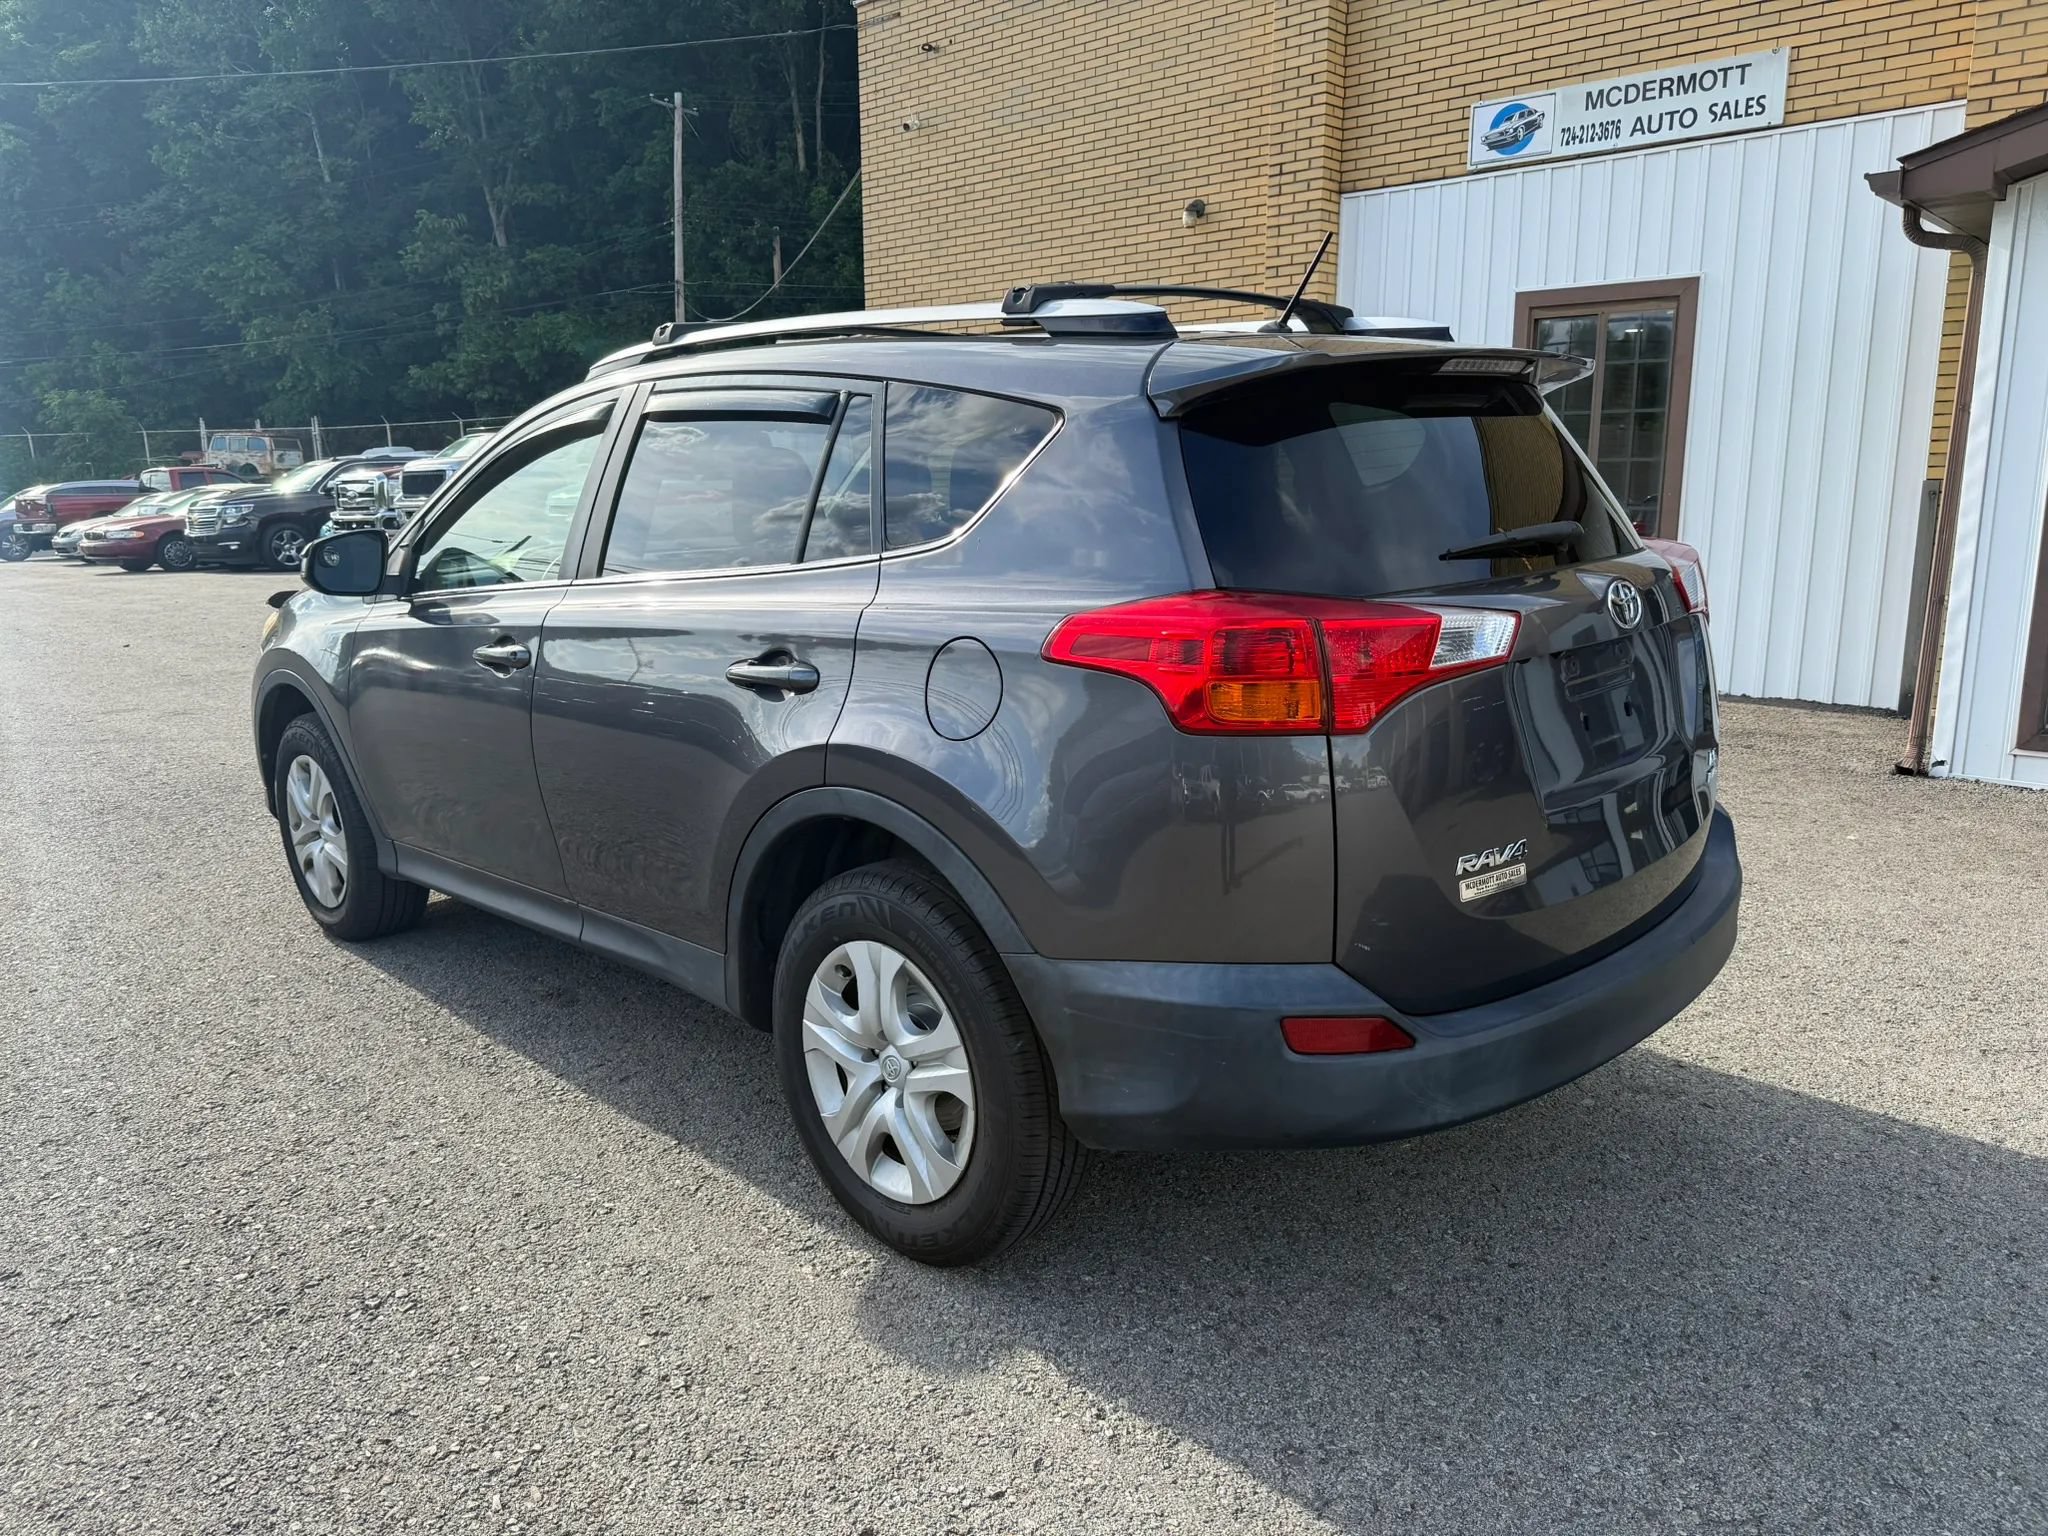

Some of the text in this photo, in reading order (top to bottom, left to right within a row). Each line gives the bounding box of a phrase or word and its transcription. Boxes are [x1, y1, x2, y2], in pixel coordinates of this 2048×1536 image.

[1584, 63, 1753, 111] MCDERMOTT
[1559, 95, 1767, 147] 724-212-3676 AUTO SALES
[1455, 839, 1527, 876] RAV4
[1465, 875, 1495, 890] MCDERMOTT
[1495, 872, 1508, 882] AUTO
[1508, 867, 1522, 878] SALES
